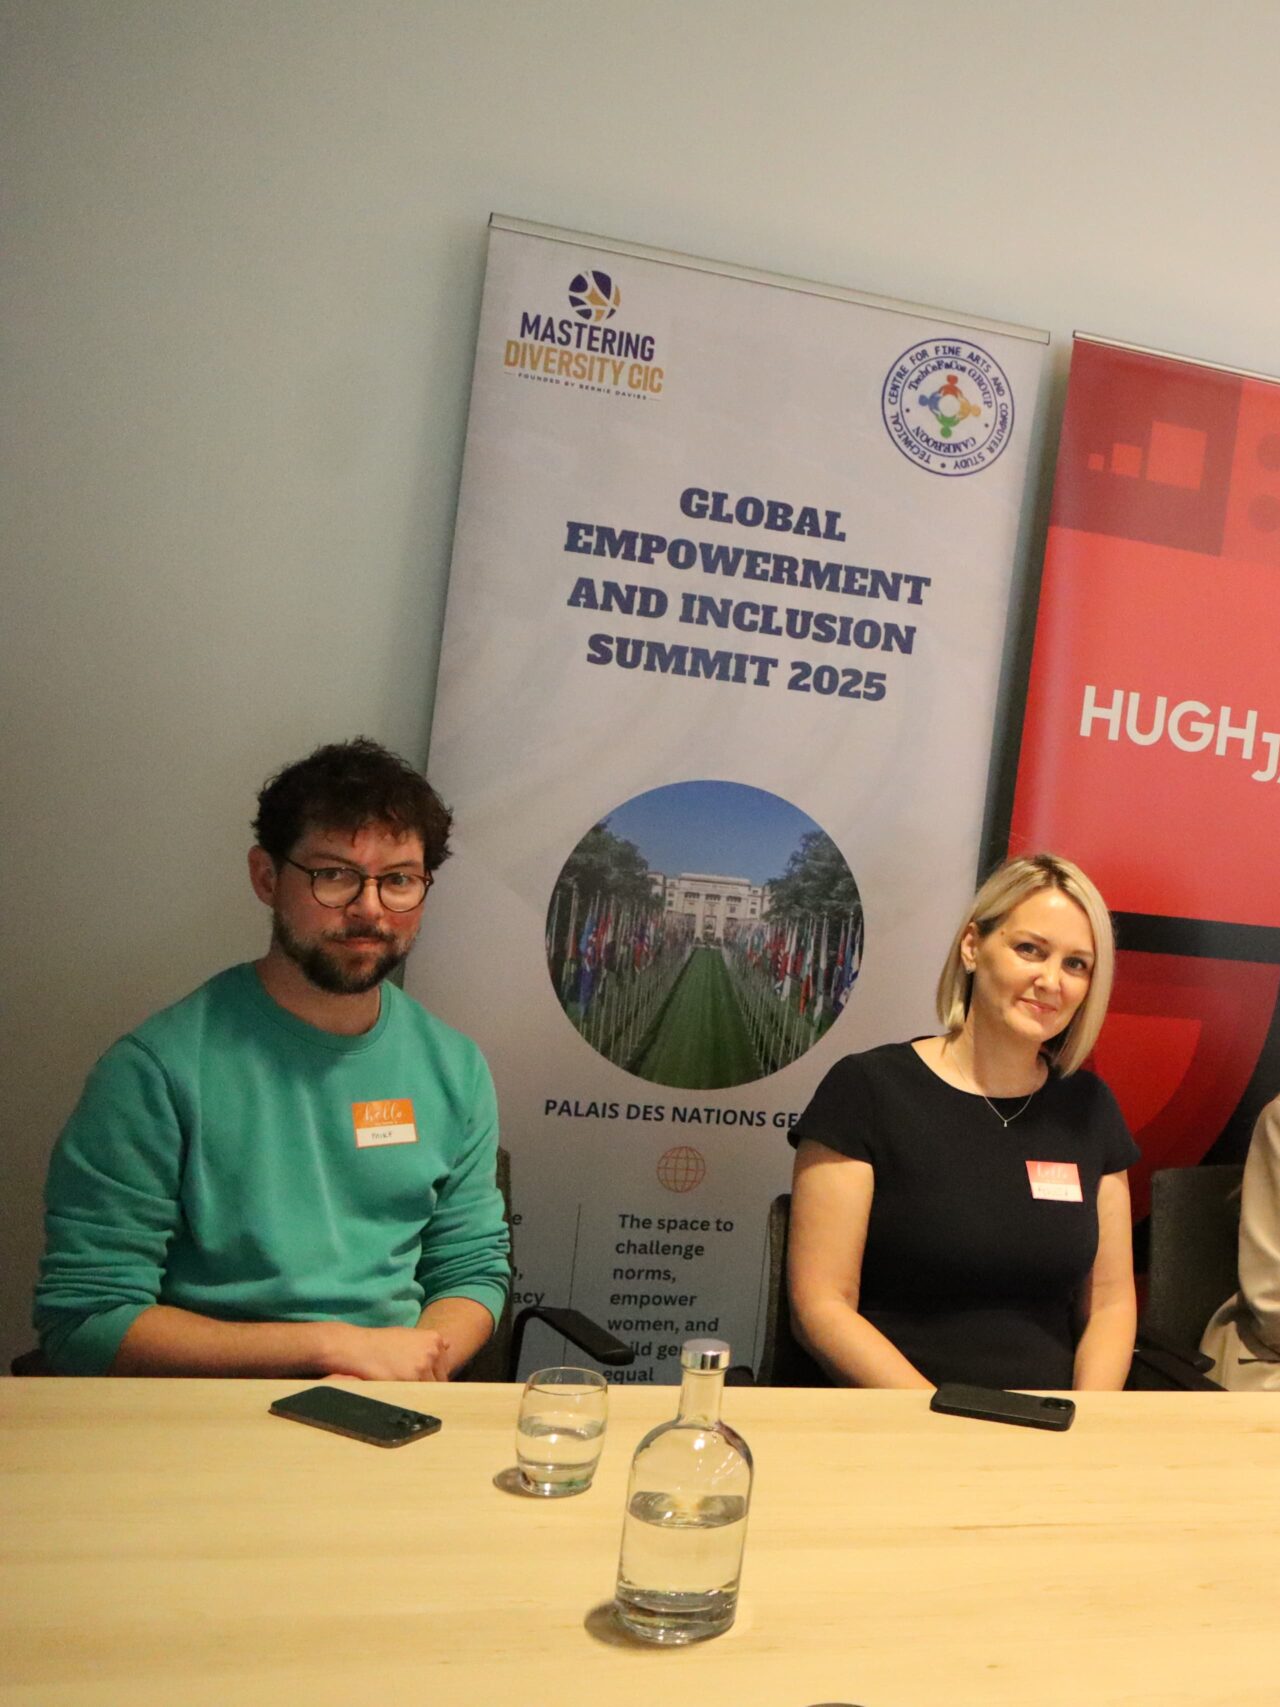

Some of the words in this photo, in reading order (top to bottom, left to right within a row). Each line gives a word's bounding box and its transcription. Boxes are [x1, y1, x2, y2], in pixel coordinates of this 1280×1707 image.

[520, 312, 655, 362] MASTERING
[909, 349, 929, 365] FOR
[934, 345, 961, 356] FINE
[967, 352, 992, 373] ARTS
[504, 340, 625, 386] DIVERSITY
[627, 362, 664, 394] CIC
[518, 372, 560, 385] FOUNDED
[888, 365, 909, 405] CENTRE
[968, 368, 992, 408] GROUP
[992, 376, 1005, 397] AND
[890, 412, 932, 464] TECHNICAL
[986, 402, 1008, 454] COMPUTER
[953, 452, 986, 470] STUDY
[679, 487, 846, 543] GLOBAL
[563, 521, 932, 606] EMPOWERMENT
[567, 576, 669, 620] AND
[678, 593, 917, 655] INCLUSION
[586, 632, 779, 687] SUMMIT
[787, 661, 888, 702] 2025
[1079, 684, 1258, 760] HUGH
[544, 1099, 619, 1119] PALAIS
[626, 1103, 665, 1122] DES
[672, 1106, 766, 1127] NATIONS
[618, 1213, 653, 1230] The
[657, 1217, 710, 1234] space
[715, 1217, 735, 1232] to
[615, 1239, 705, 1260] challenge
[612, 1266, 677, 1284] norms,
[609, 1292, 697, 1310] empower
[607, 1318, 680, 1334] women,
[685, 1318, 719, 1332] and
[602, 1367, 654, 1385] equal
